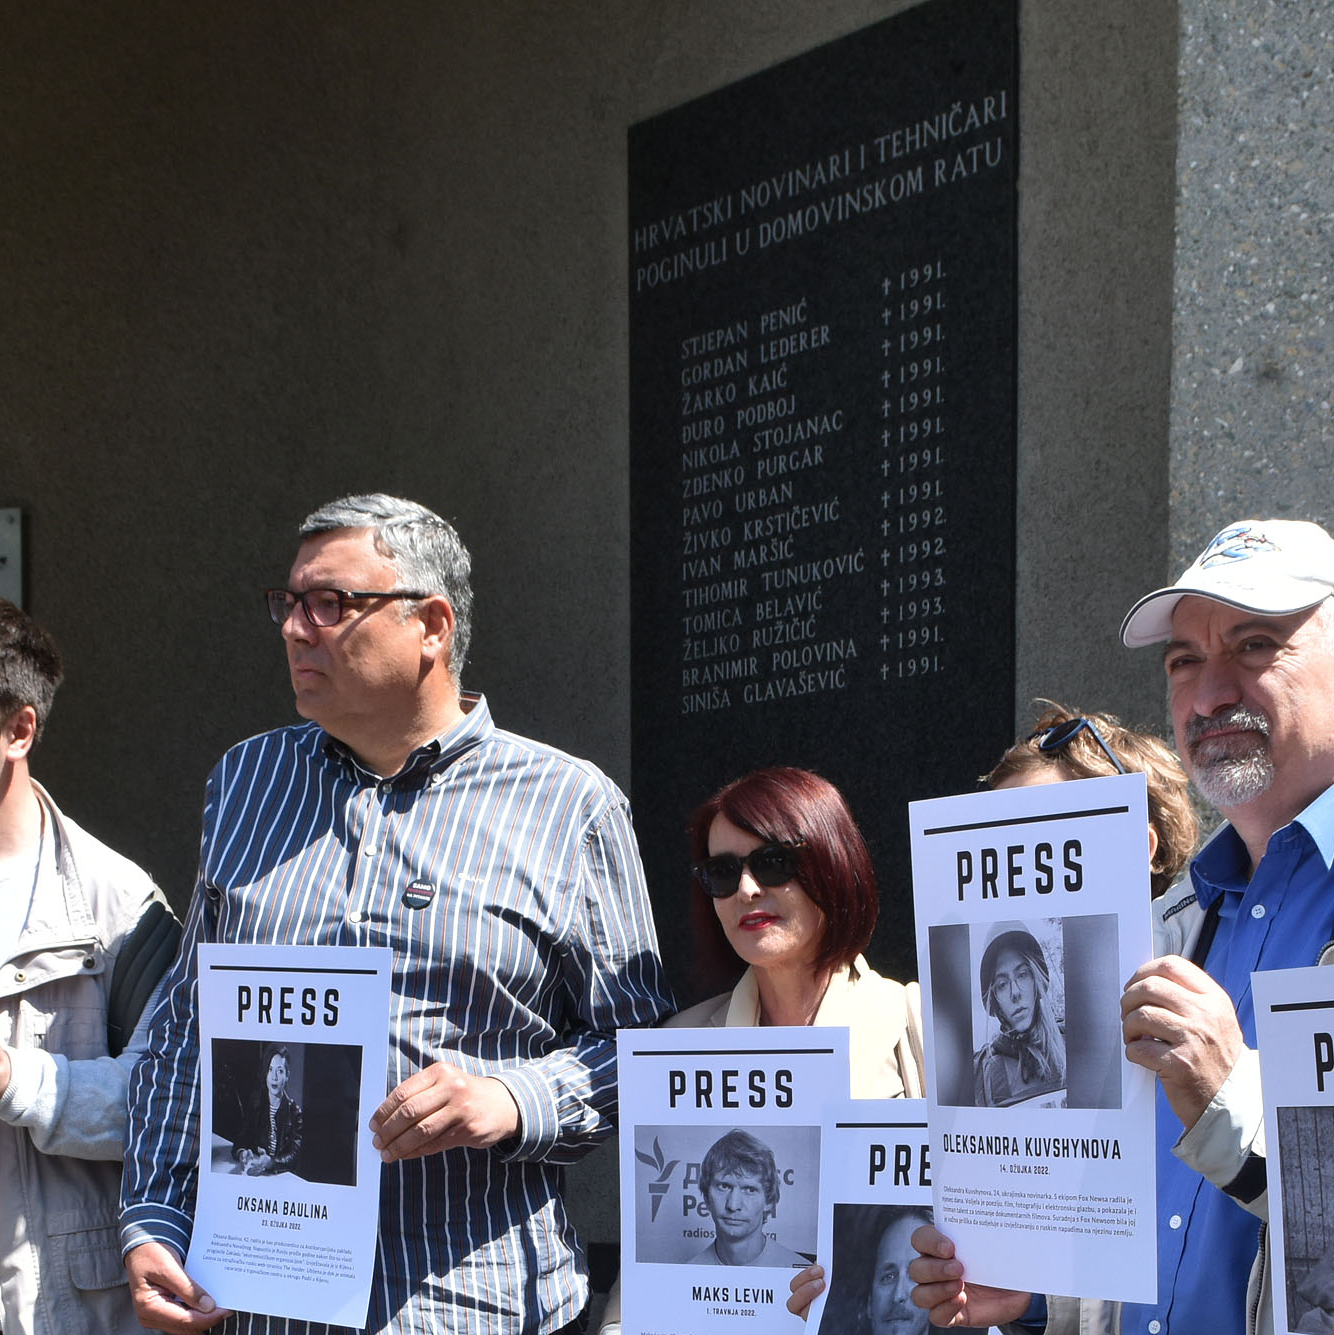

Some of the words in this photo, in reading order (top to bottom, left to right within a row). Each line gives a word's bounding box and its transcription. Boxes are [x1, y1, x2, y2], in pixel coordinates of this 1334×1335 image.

[635, 195, 732, 251] HRVATSKI
[741, 149, 850, 215] NOVINARI
[860, 144, 866, 171] I
[875, 90, 1008, 164] TEHNIČARI
[637, 238, 727, 292] POGINULI
[736, 229, 750, 256] U
[759, 166, 924, 249] DOMOVINSKOM
[935, 137, 1002, 188] RATU
[682, 320, 748, 360] STJEPAN
[761, 298, 808, 336] PENIĆ
[901, 260, 947, 291] 1991.
[682, 350, 748, 386] GORDAN
[761, 325, 831, 364] LEDERER
[901, 291, 946, 322] 1991.
[682, 382, 737, 416] ŽARKO
[749, 365, 788, 398] KAIĆ
[901, 324, 946, 353] 1991.
[683, 416, 725, 445] ĐURO
[737, 394, 796, 430] PODBOJ
[900, 356, 946, 385] 1991.
[683, 440, 741, 471] NIKOLA
[753, 410, 844, 453] STOJANAC
[900, 386, 945, 414] 1991.
[683, 466, 745, 499] ZDENKO
[757, 445, 824, 480] PURGAR
[900, 417, 945, 444] 1991.
[683, 500, 724, 527] PAVO
[735, 481, 793, 513] URBAN
[900, 447, 945, 474] 1991.
[683, 527, 732, 555] ŽIVKO
[744, 496, 840, 542] KRSTIČEVIĆ
[900, 480, 944, 506] 1991.
[683, 555, 722, 582] IVAN
[734, 534, 795, 571] MARŠIĆ
[899, 506, 948, 534] 1992.
[683, 578, 748, 609] TIHOMIR
[761, 548, 865, 592] TUNUKOVIĆ
[899, 537, 947, 564] 1992.
[683, 607, 743, 636] TOMICA
[756, 586, 823, 622] BELAVIĆ
[899, 568, 947, 594] 1993.
[683, 634, 740, 662] ŽELJKO
[753, 614, 817, 650] RUŽIČIĆ
[899, 596, 946, 622] 1993.
[682, 686, 732, 715] SINIŠA
[744, 663, 846, 704] GLAVAŠEVIĆ
[899, 655, 945, 679] 1991.
[683, 656, 759, 687] BRANIMIR
[773, 638, 858, 672] POLOVINA
[899, 625, 945, 650] 1991.
[957, 839, 1083, 901] PRESS
[238, 985, 339, 1027] PRESS
[669, 1069, 793, 1108] PRESS
[868, 1144, 931, 1187] PRE
[943, 1133, 1019, 1156] OLEKSANDRA
[1025, 1137, 1121, 1160] KUVSHYNOVA
[999, 1164, 1009, 1173] 14.
[1009, 1164, 1032, 1174] OŽUJKA
[1033, 1165, 1050, 1175] 2022.
[237, 1196, 278, 1215] OKSANA
[283, 1201, 327, 1220] BAULINA
[692, 1286, 729, 1302] MAKS
[735, 1288, 773, 1304] LEVIN
[741, 1309, 755, 1317] 2022.
